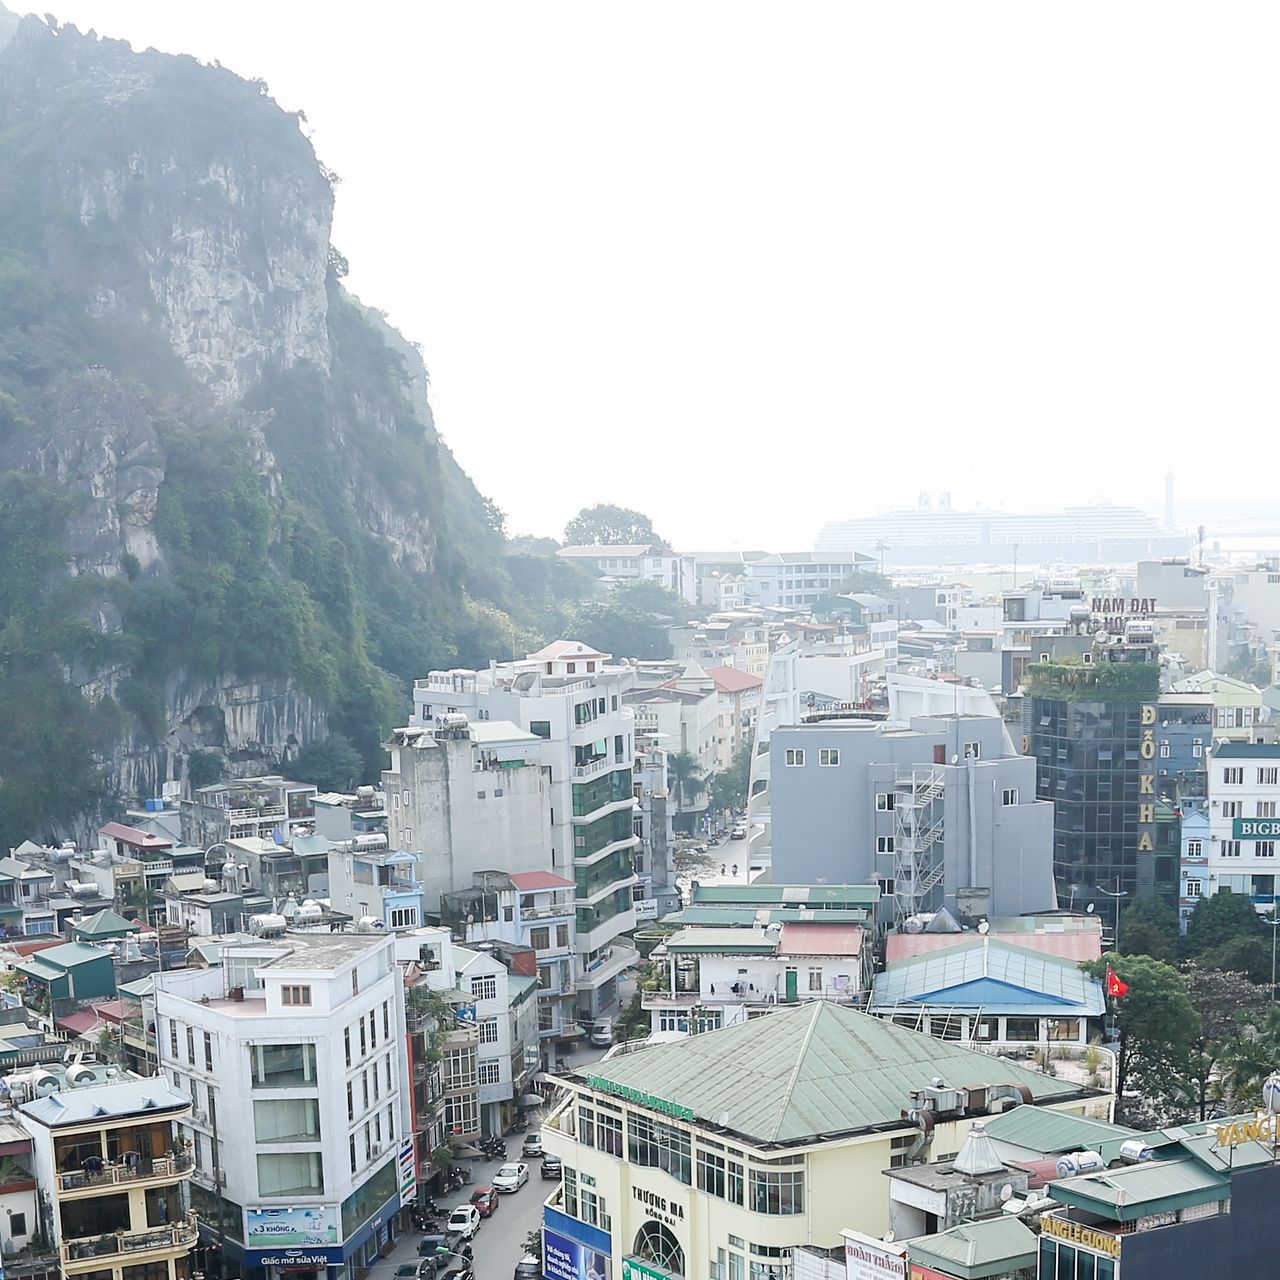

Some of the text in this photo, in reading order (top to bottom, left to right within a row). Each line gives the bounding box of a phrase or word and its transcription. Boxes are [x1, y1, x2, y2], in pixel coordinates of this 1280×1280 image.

[1092, 598, 1125, 613] NAM
[261, 1256, 280, 1265] Giấc
[312, 1255, 327, 1265] Việt
